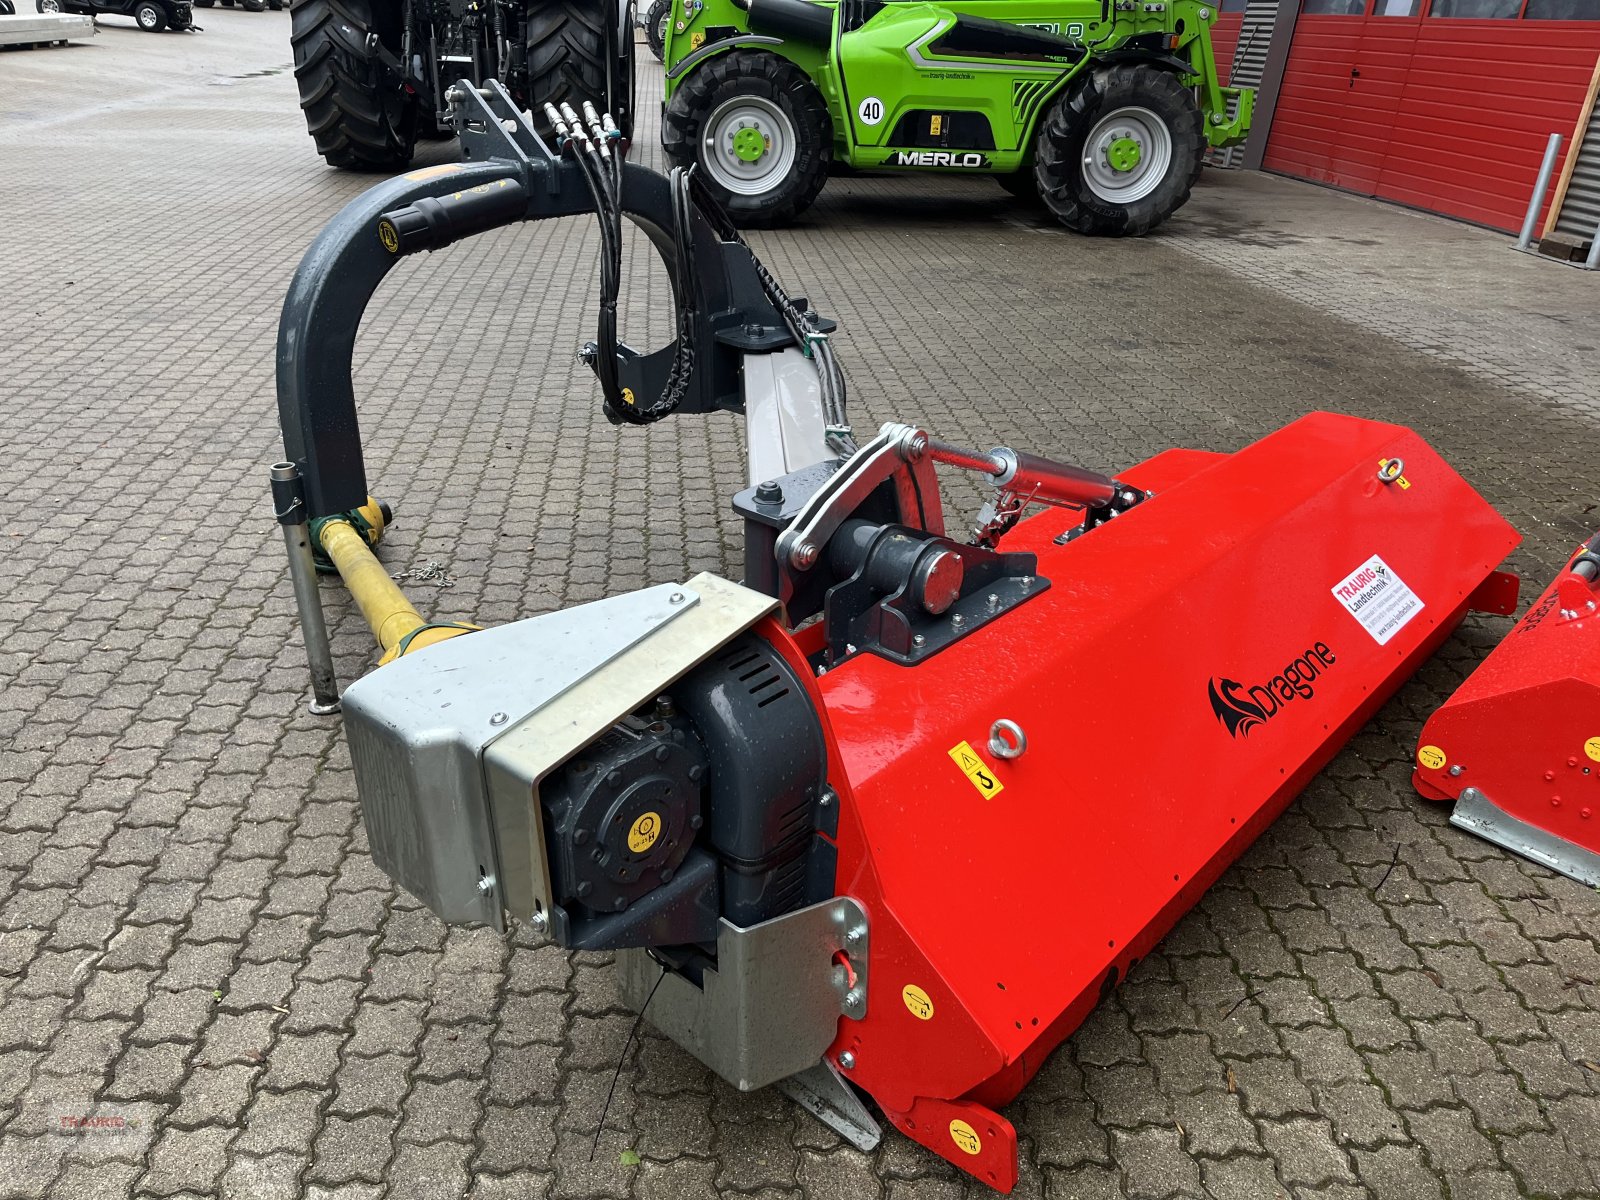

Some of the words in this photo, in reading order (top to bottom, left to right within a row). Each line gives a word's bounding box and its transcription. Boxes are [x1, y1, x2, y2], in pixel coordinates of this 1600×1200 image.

[863, 102, 880, 120] 40
[898, 151, 982, 168] MERLO
[1337, 567, 1376, 602] TRAURIG
[1348, 578, 1388, 613] Landtechnik
[1248, 641, 1336, 718] Dragone
